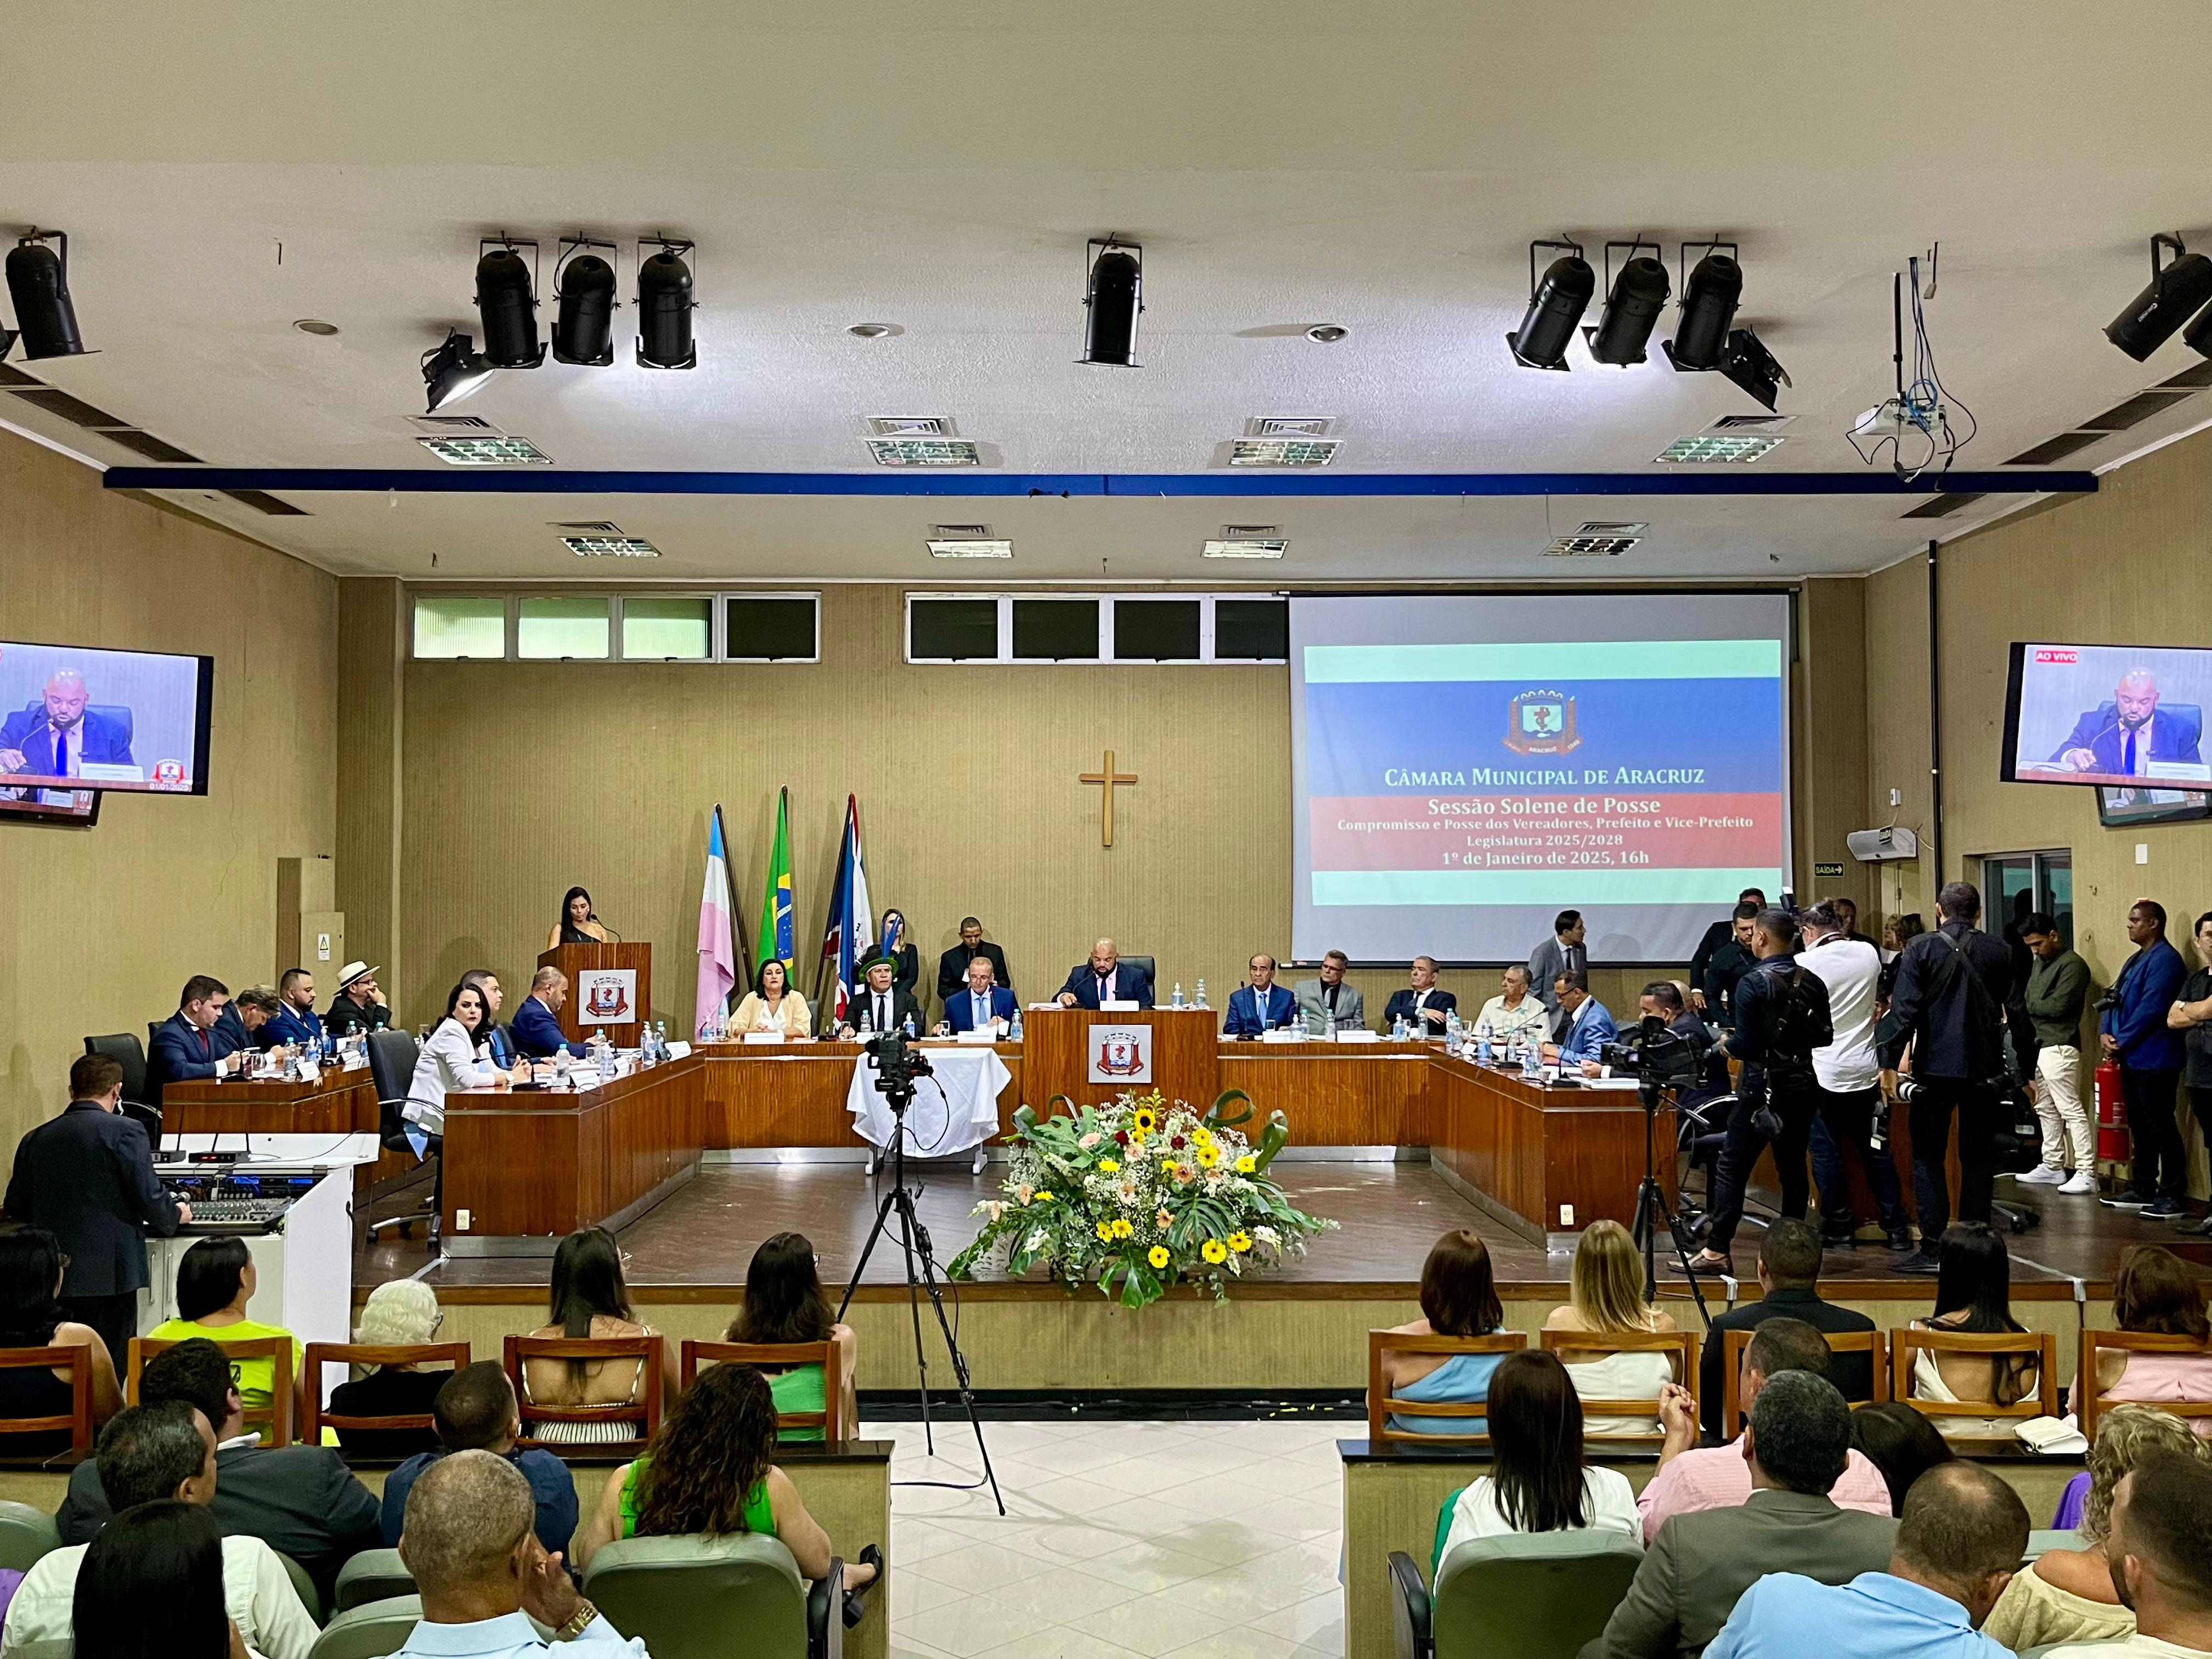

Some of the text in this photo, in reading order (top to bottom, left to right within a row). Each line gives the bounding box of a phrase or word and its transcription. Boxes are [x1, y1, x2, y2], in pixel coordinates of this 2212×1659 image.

[2036, 652, 2077, 661] AO VIVO
[1385, 766, 1705, 786] CÂMARA MUNICIPAL DE ARACRUZ
[149, 783, 189, 791] 01/01/2025
[1428, 797, 1661, 815] Sessão Solene de Posse
[1338, 816, 1753, 833] Compromisso e Posse dos Vereadores, Prefeito e Vice-Prefeito
[1467, 834, 1623, 849] Legislatura 2025/2028
[1463, 852, 1482, 865] de
[1486, 851, 1543, 867] Janeiro
[1547, 851, 1566, 864] de
[1570, 851, 1615, 865] 2025,
[1620, 850, 1649, 864] 16h
[1816, 865, 1836, 874] SAÍDA
